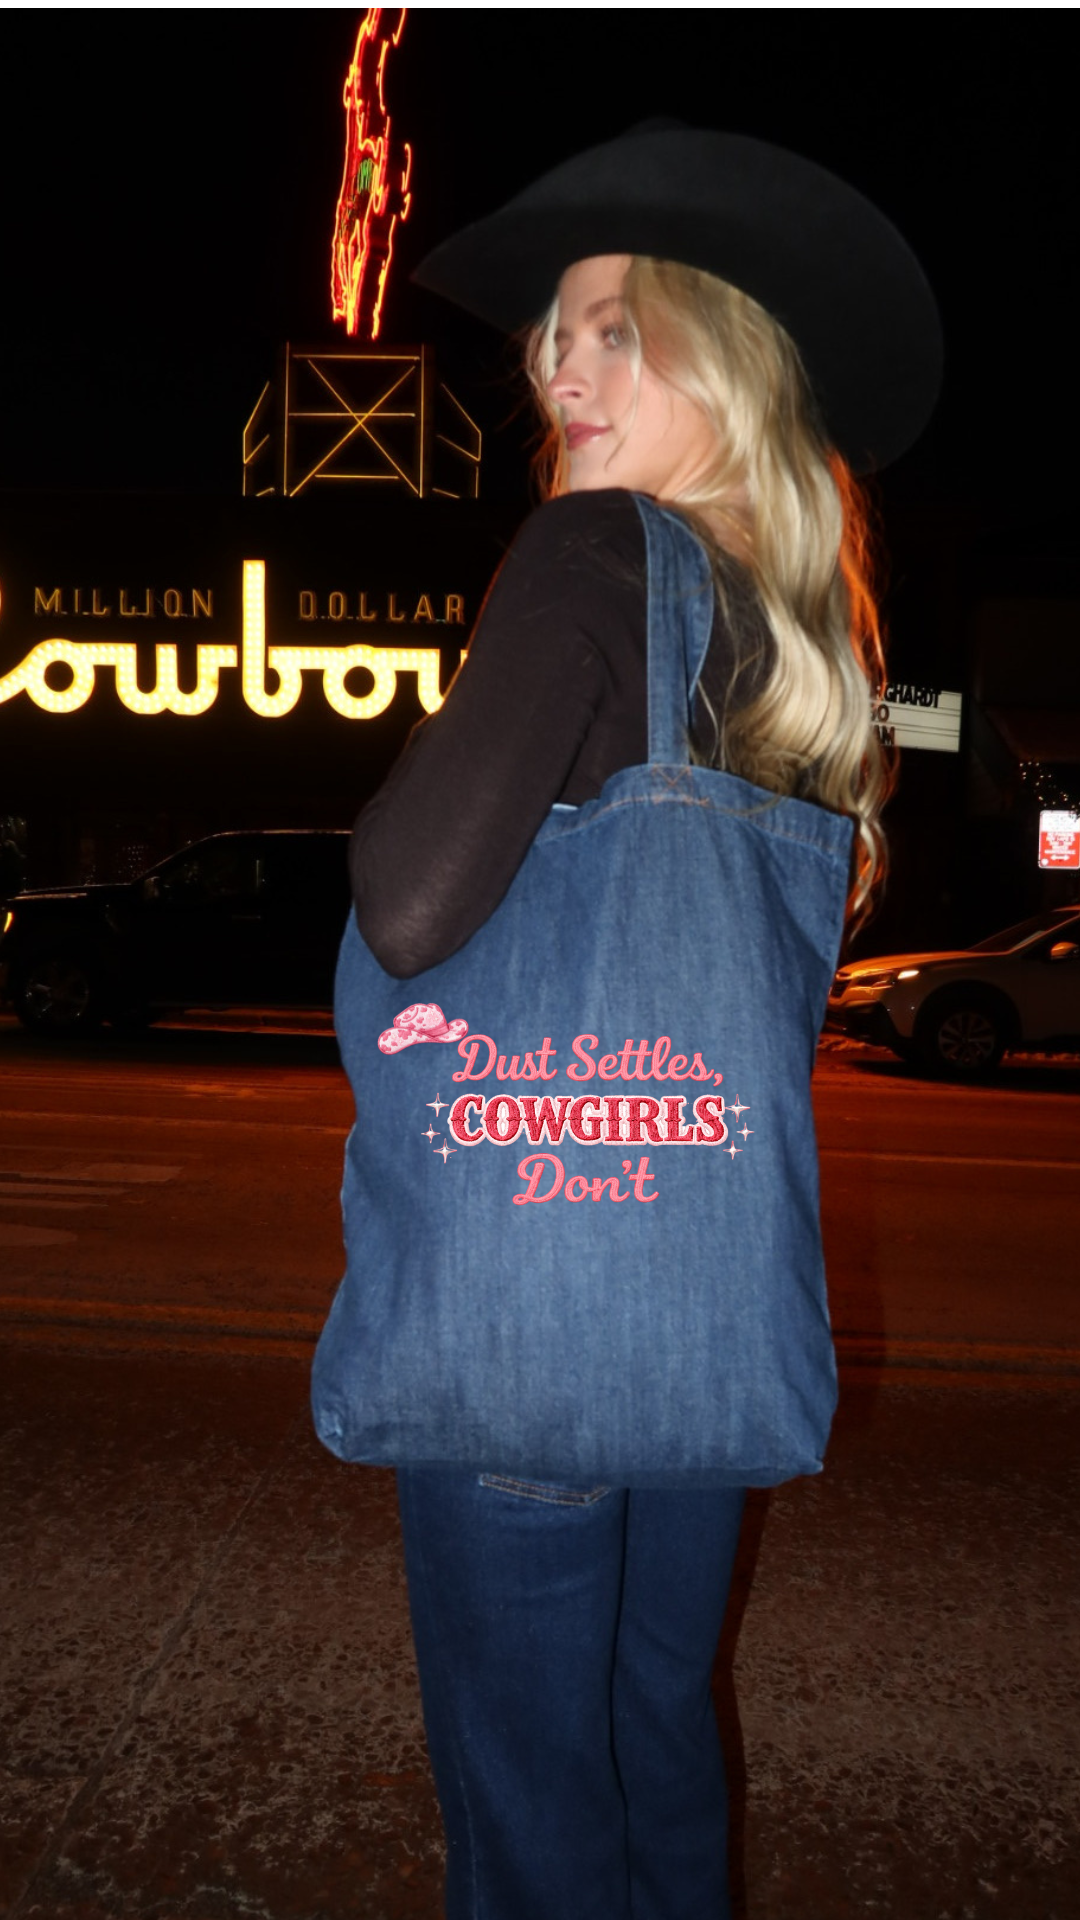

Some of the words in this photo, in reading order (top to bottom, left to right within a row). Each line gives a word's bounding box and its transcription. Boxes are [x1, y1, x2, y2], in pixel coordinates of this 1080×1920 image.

[34, 586, 213, 618] MILLION
[299, 590, 465, 624] DOLLAR
[0, 560, 468, 719] owbo
[452, 1034, 558, 1082] Dust
[566, 1033, 723, 1087] Settles,
[447, 1094, 729, 1147] COWGIRLS
[512, 1152, 660, 1206] Don't
